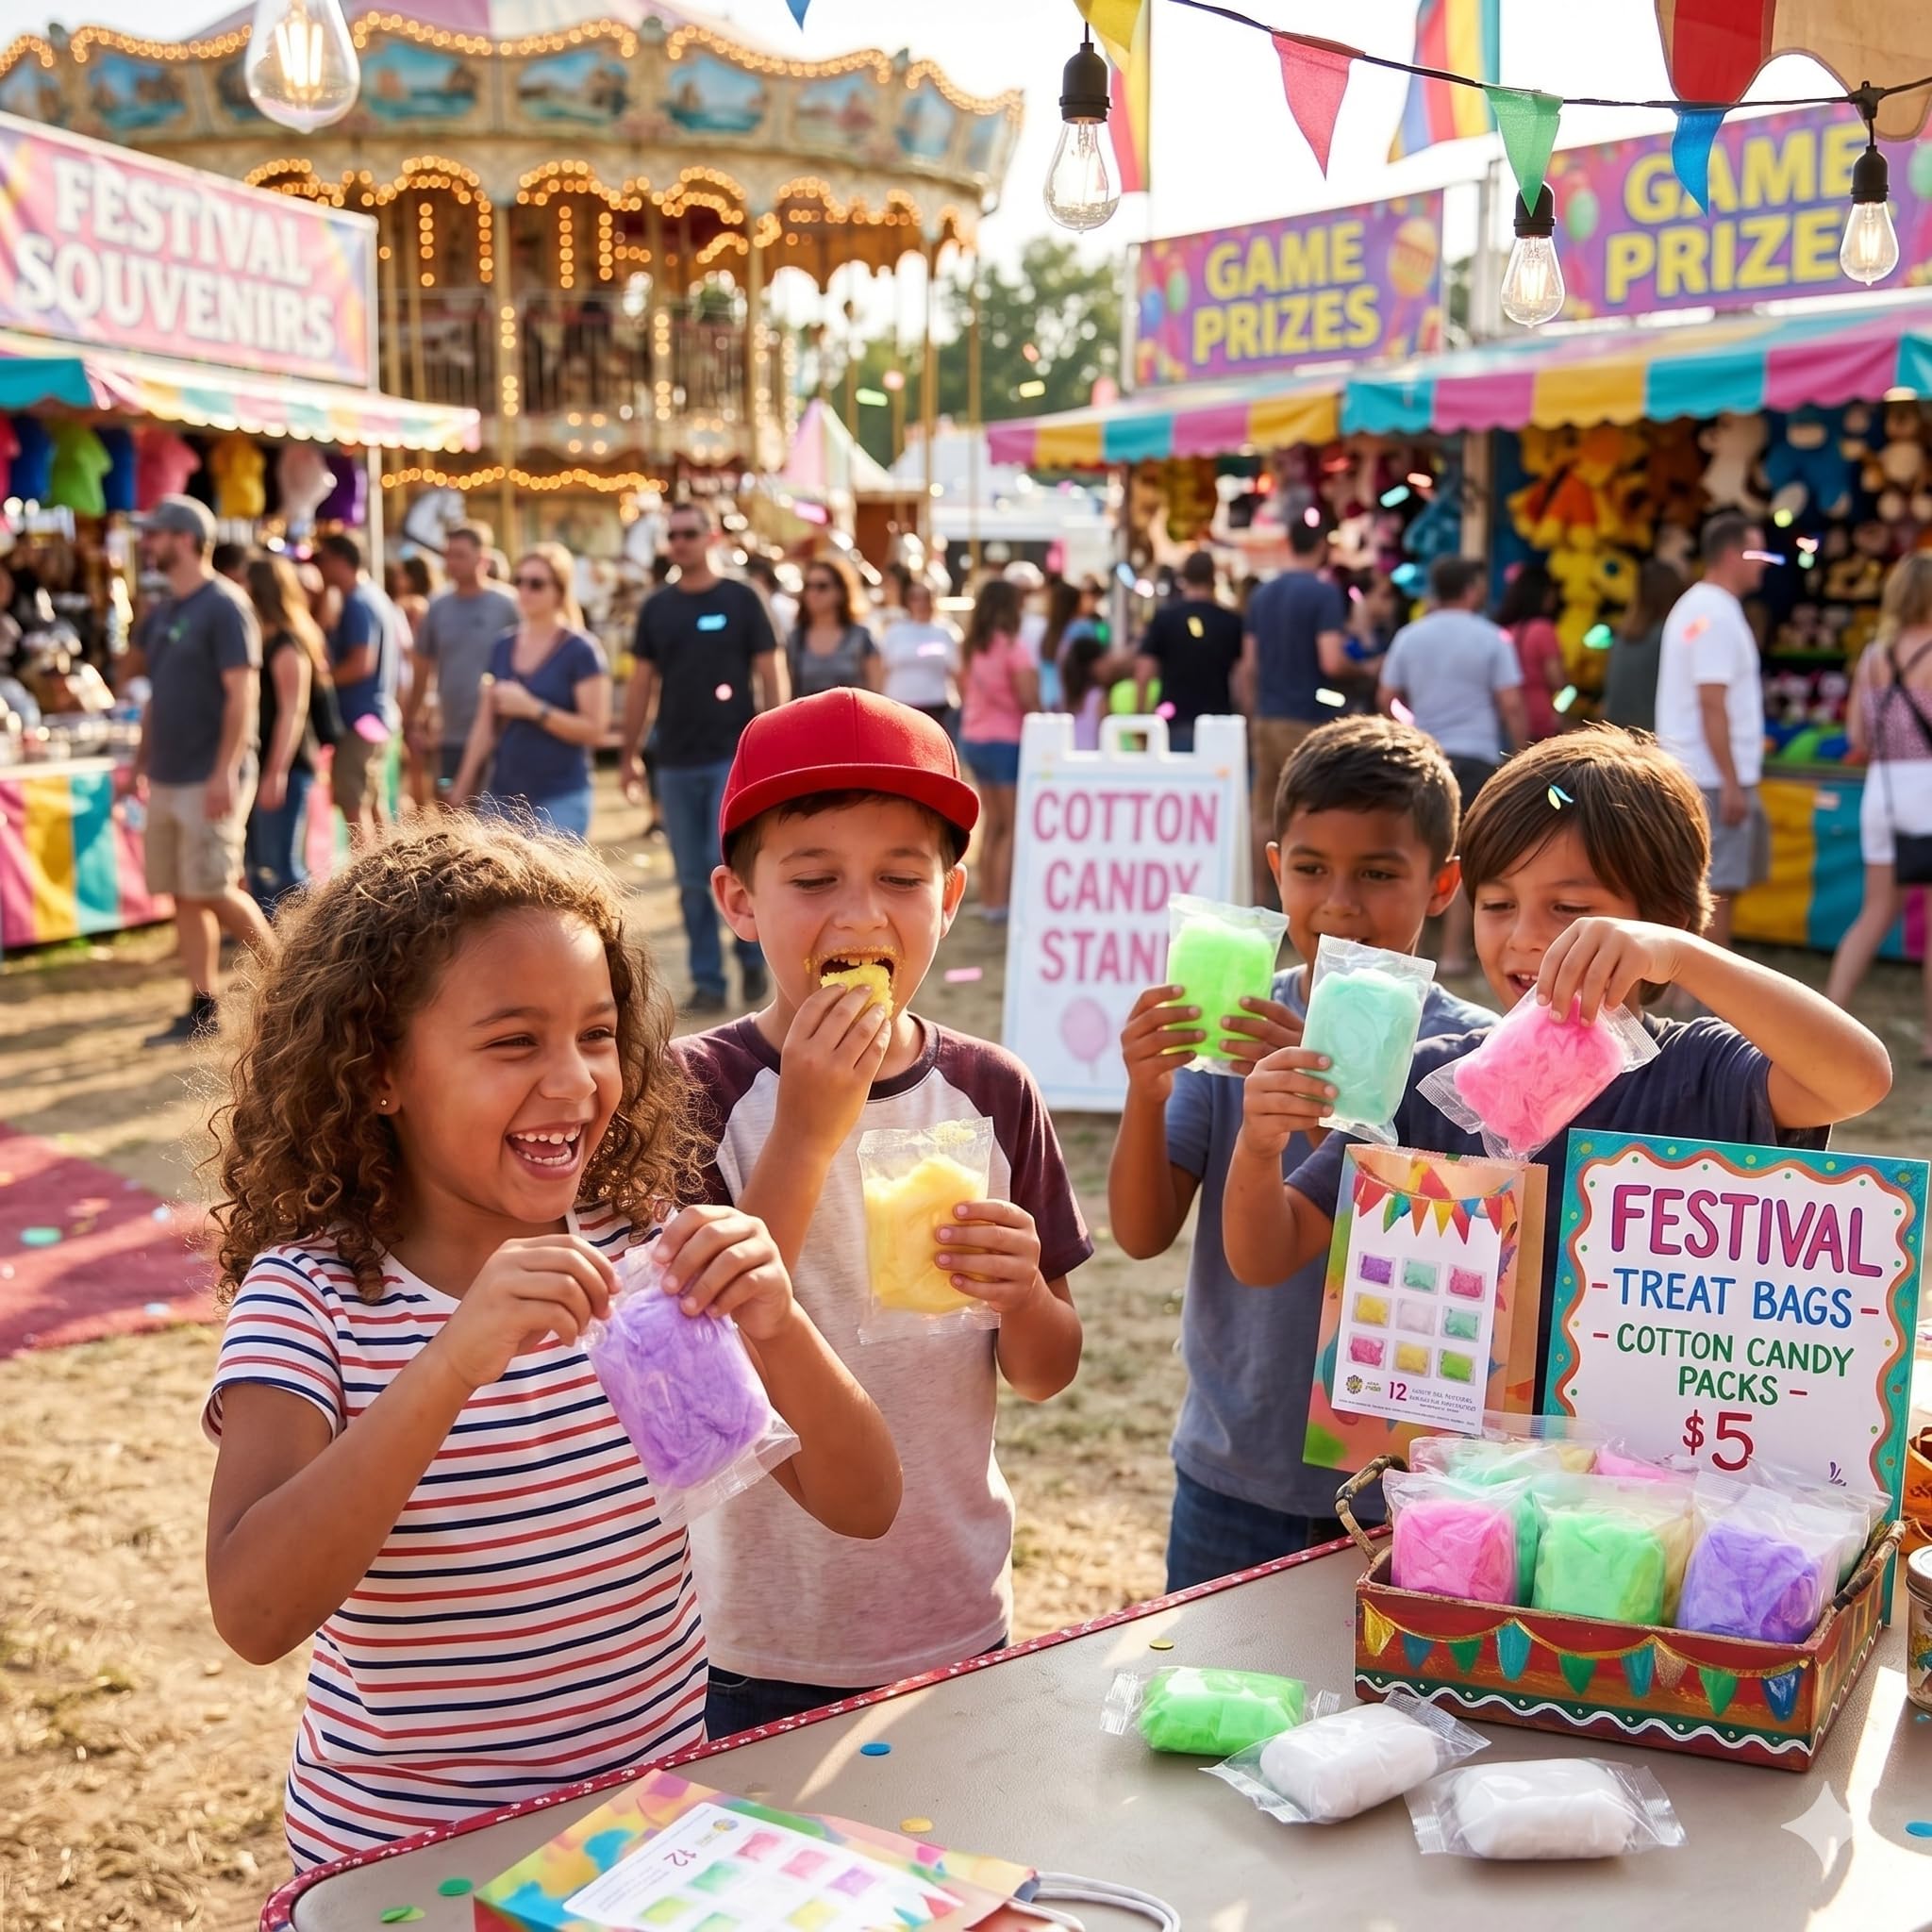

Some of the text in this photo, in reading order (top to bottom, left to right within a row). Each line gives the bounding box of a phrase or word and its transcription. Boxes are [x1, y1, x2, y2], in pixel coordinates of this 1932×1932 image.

[1624, 119, 1871, 225] GAME
[52, 155, 312, 285] FESTIVAL
[1205, 220, 1367, 302] GAME
[1606, 200, 1897, 305] PRIZE
[15, 232, 335, 360] SOUVENIRS
[1191, 284, 1381, 365] PRIZES
[1032, 791, 1220, 845] COTTON
[1044, 858, 1202, 914] CANDY
[1041, 928, 1170, 984] STAN
[1611, 1184, 1883, 1277] FESTIVAL
[1613, 1267, 1852, 1328] TREAT BAGS
[1616, 1323, 1855, 1376] COTTON CANDY
[1389, 1381, 1407, 1402] 12
[1678, 1366, 1778, 1406] PACKS
[1682, 1408, 1754, 1472] $5
